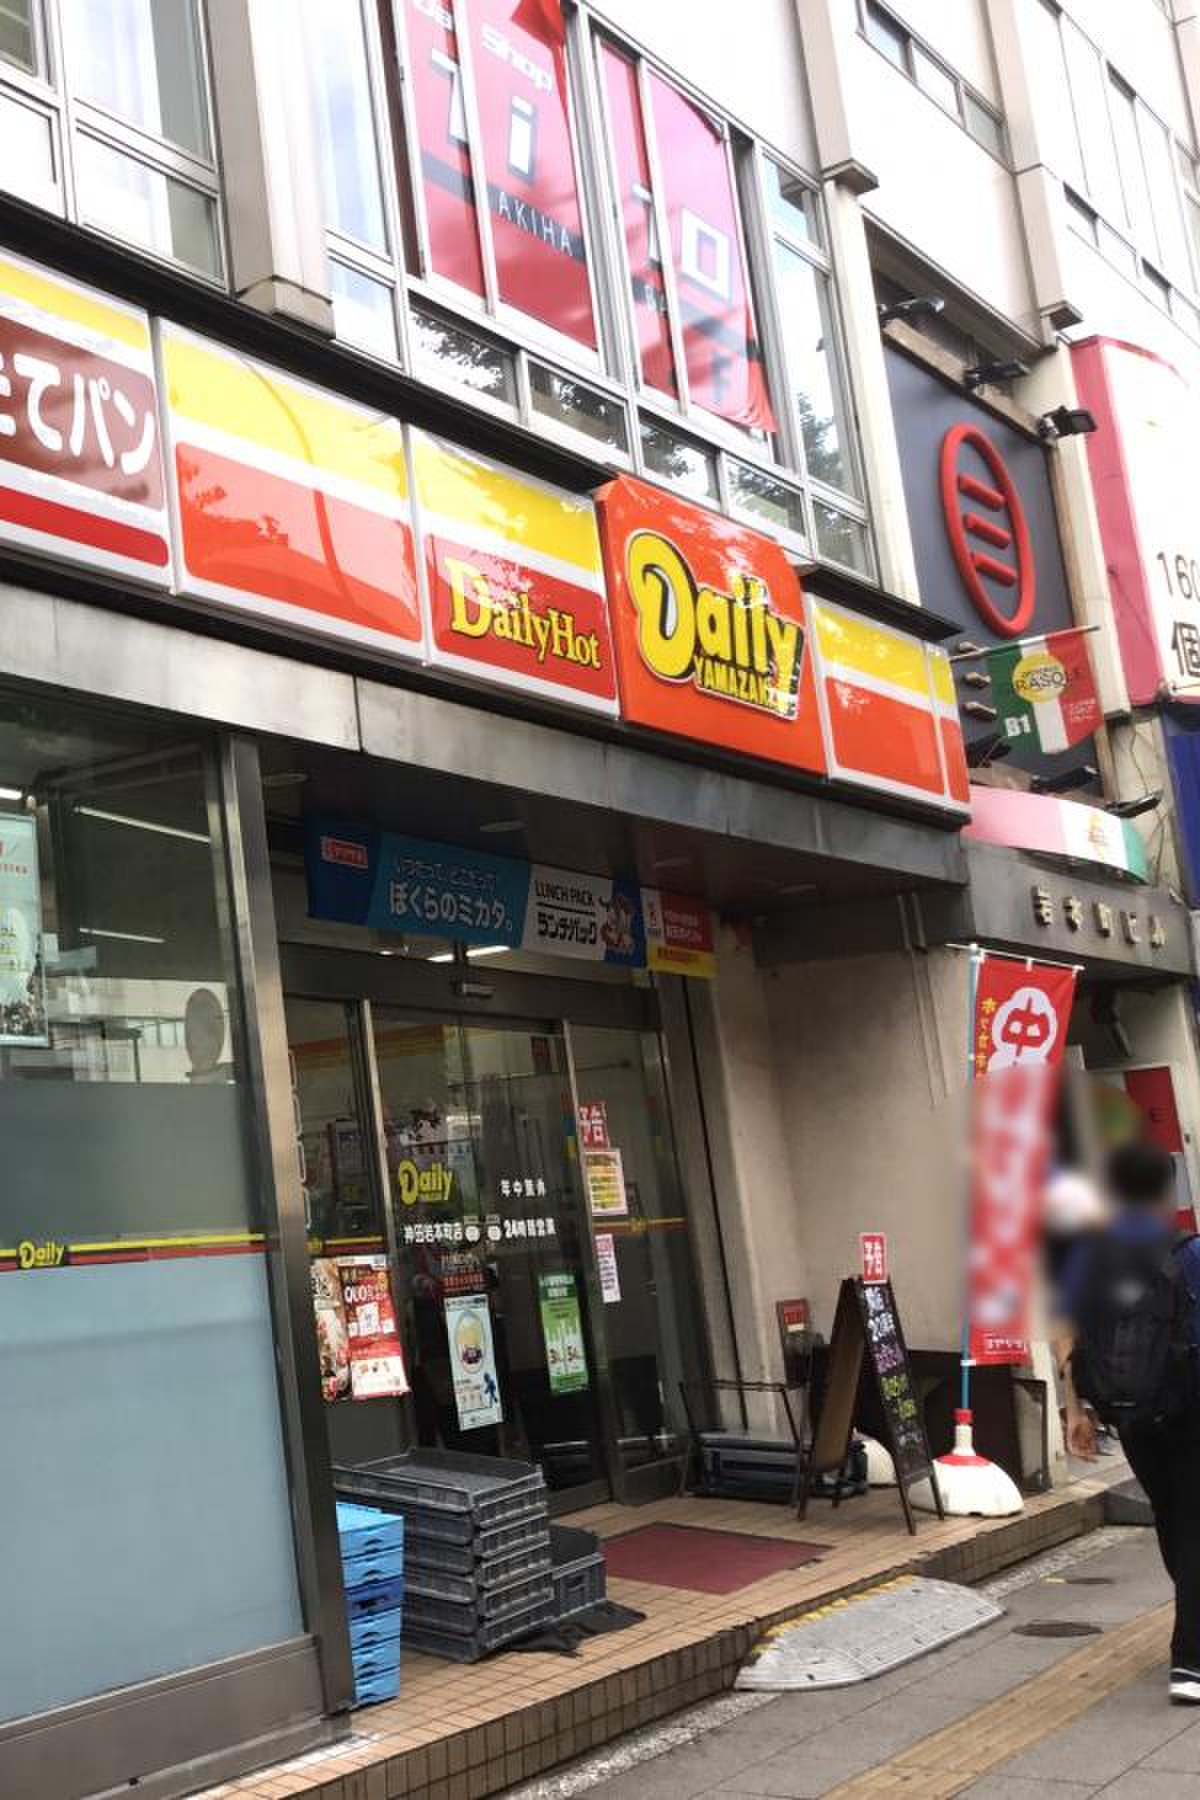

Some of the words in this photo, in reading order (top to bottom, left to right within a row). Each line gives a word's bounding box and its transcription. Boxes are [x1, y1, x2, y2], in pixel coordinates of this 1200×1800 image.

[499, 191, 574, 257] AKIHA
[627, 531, 800, 703] Daily
[399, 1159, 453, 1205] Daily
[20, 1239, 65, 1268] Daily
